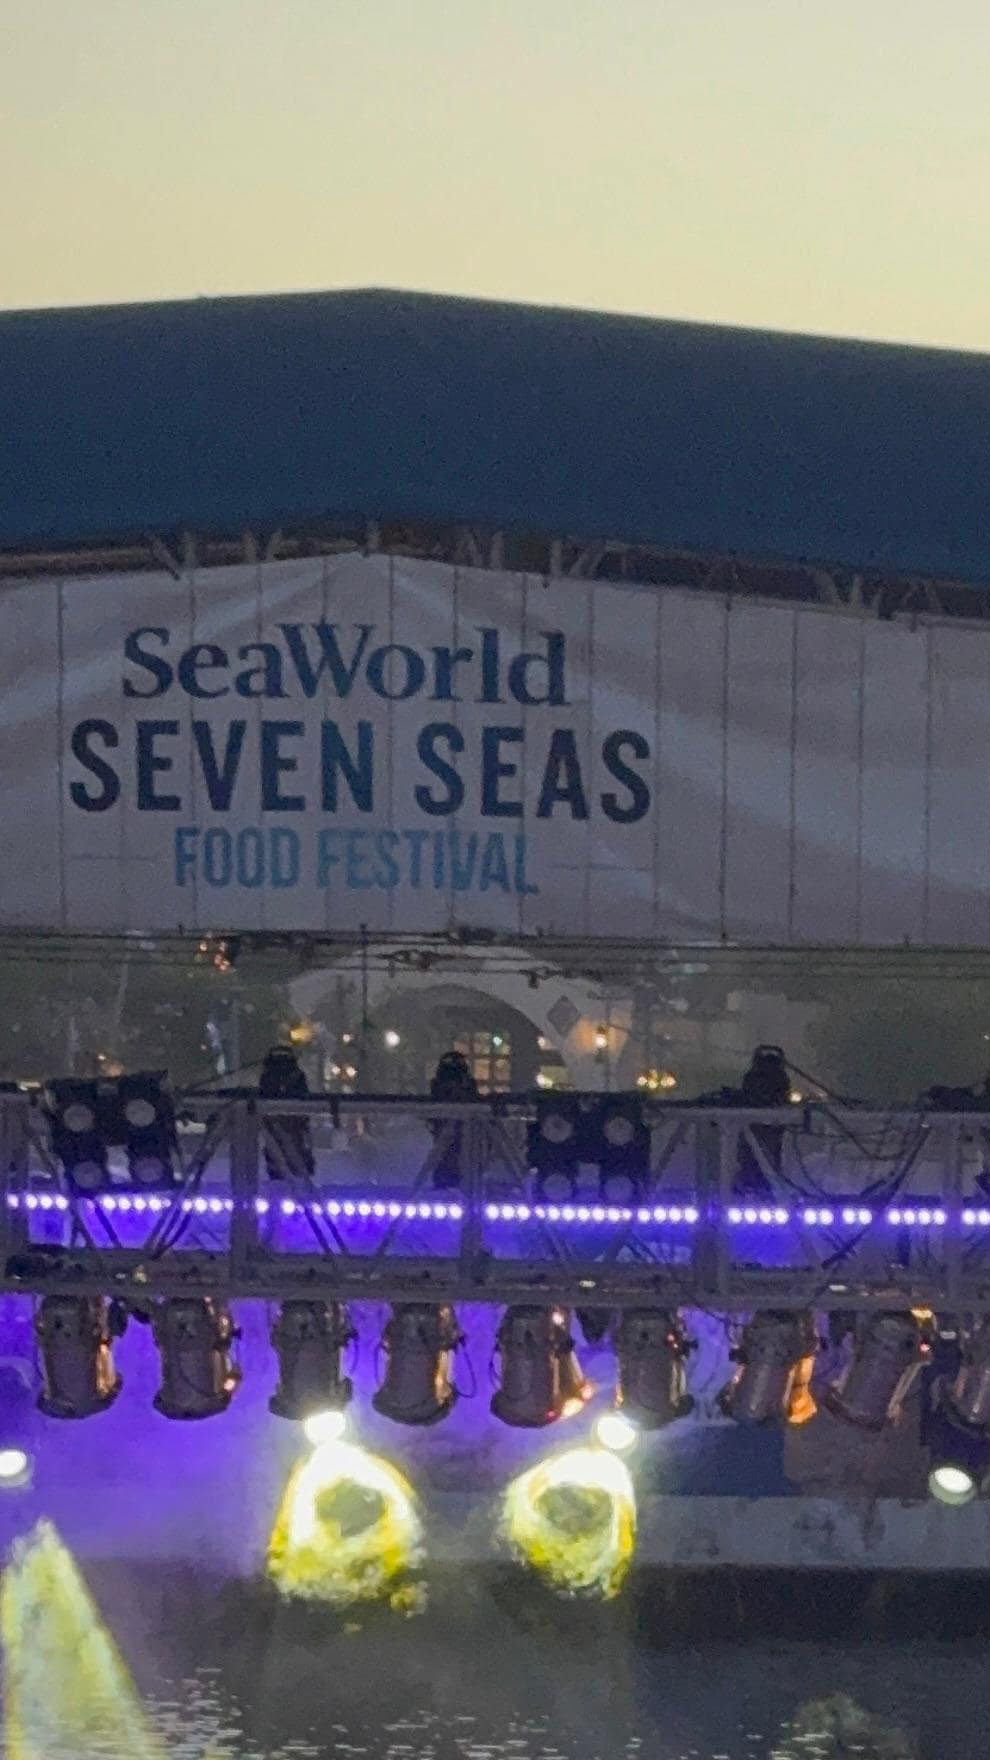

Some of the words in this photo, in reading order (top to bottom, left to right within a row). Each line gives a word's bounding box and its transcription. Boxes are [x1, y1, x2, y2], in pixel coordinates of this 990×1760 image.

[121, 615, 572, 706] SeaWorld
[68, 719, 374, 813] SEVEN
[414, 723, 652, 824] SEAS
[174, 826, 299, 888] FOOD
[315, 828, 539, 895] FESTIVAL
